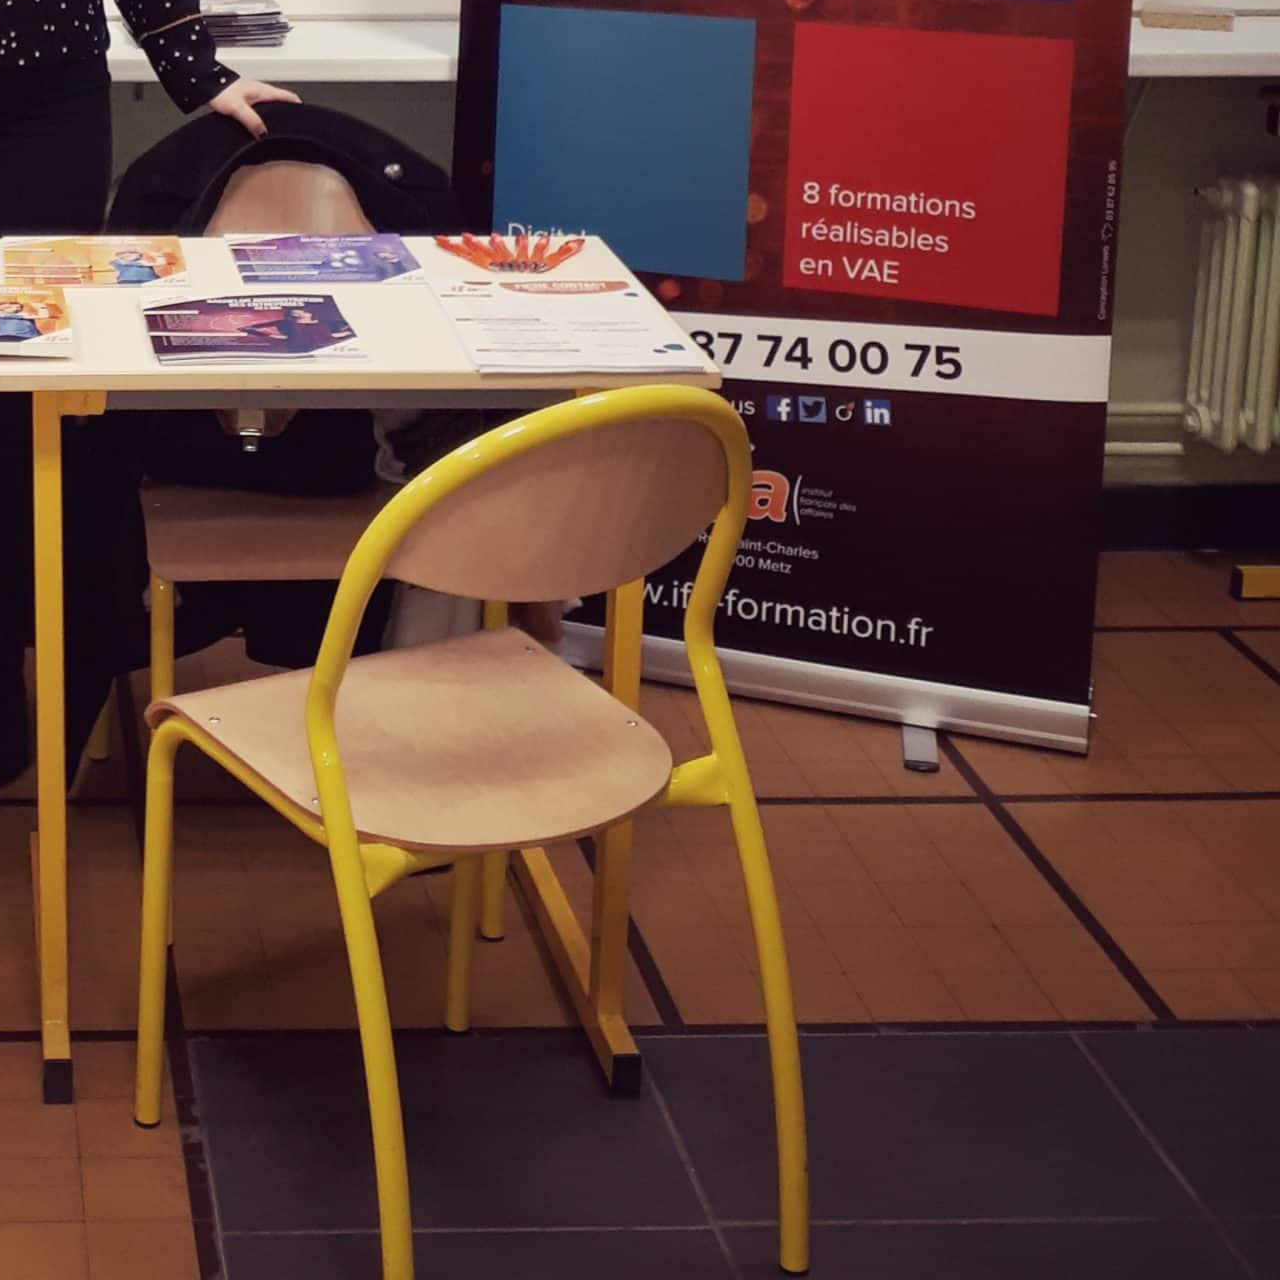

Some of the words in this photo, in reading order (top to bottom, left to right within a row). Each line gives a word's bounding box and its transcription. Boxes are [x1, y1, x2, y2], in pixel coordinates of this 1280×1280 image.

[802, 182, 820, 206] 8
[829, 183, 976, 220] formations
[801, 217, 949, 254] réalisables
[799, 258, 833, 278] en
[843, 258, 900, 285] VAE
[757, 334, 813, 370] 74
[828, 338, 889, 375] 00
[904, 343, 963, 380] 75
[738, 538, 820, 560] aint-Charles
[758, 557, 793, 574] Metz
